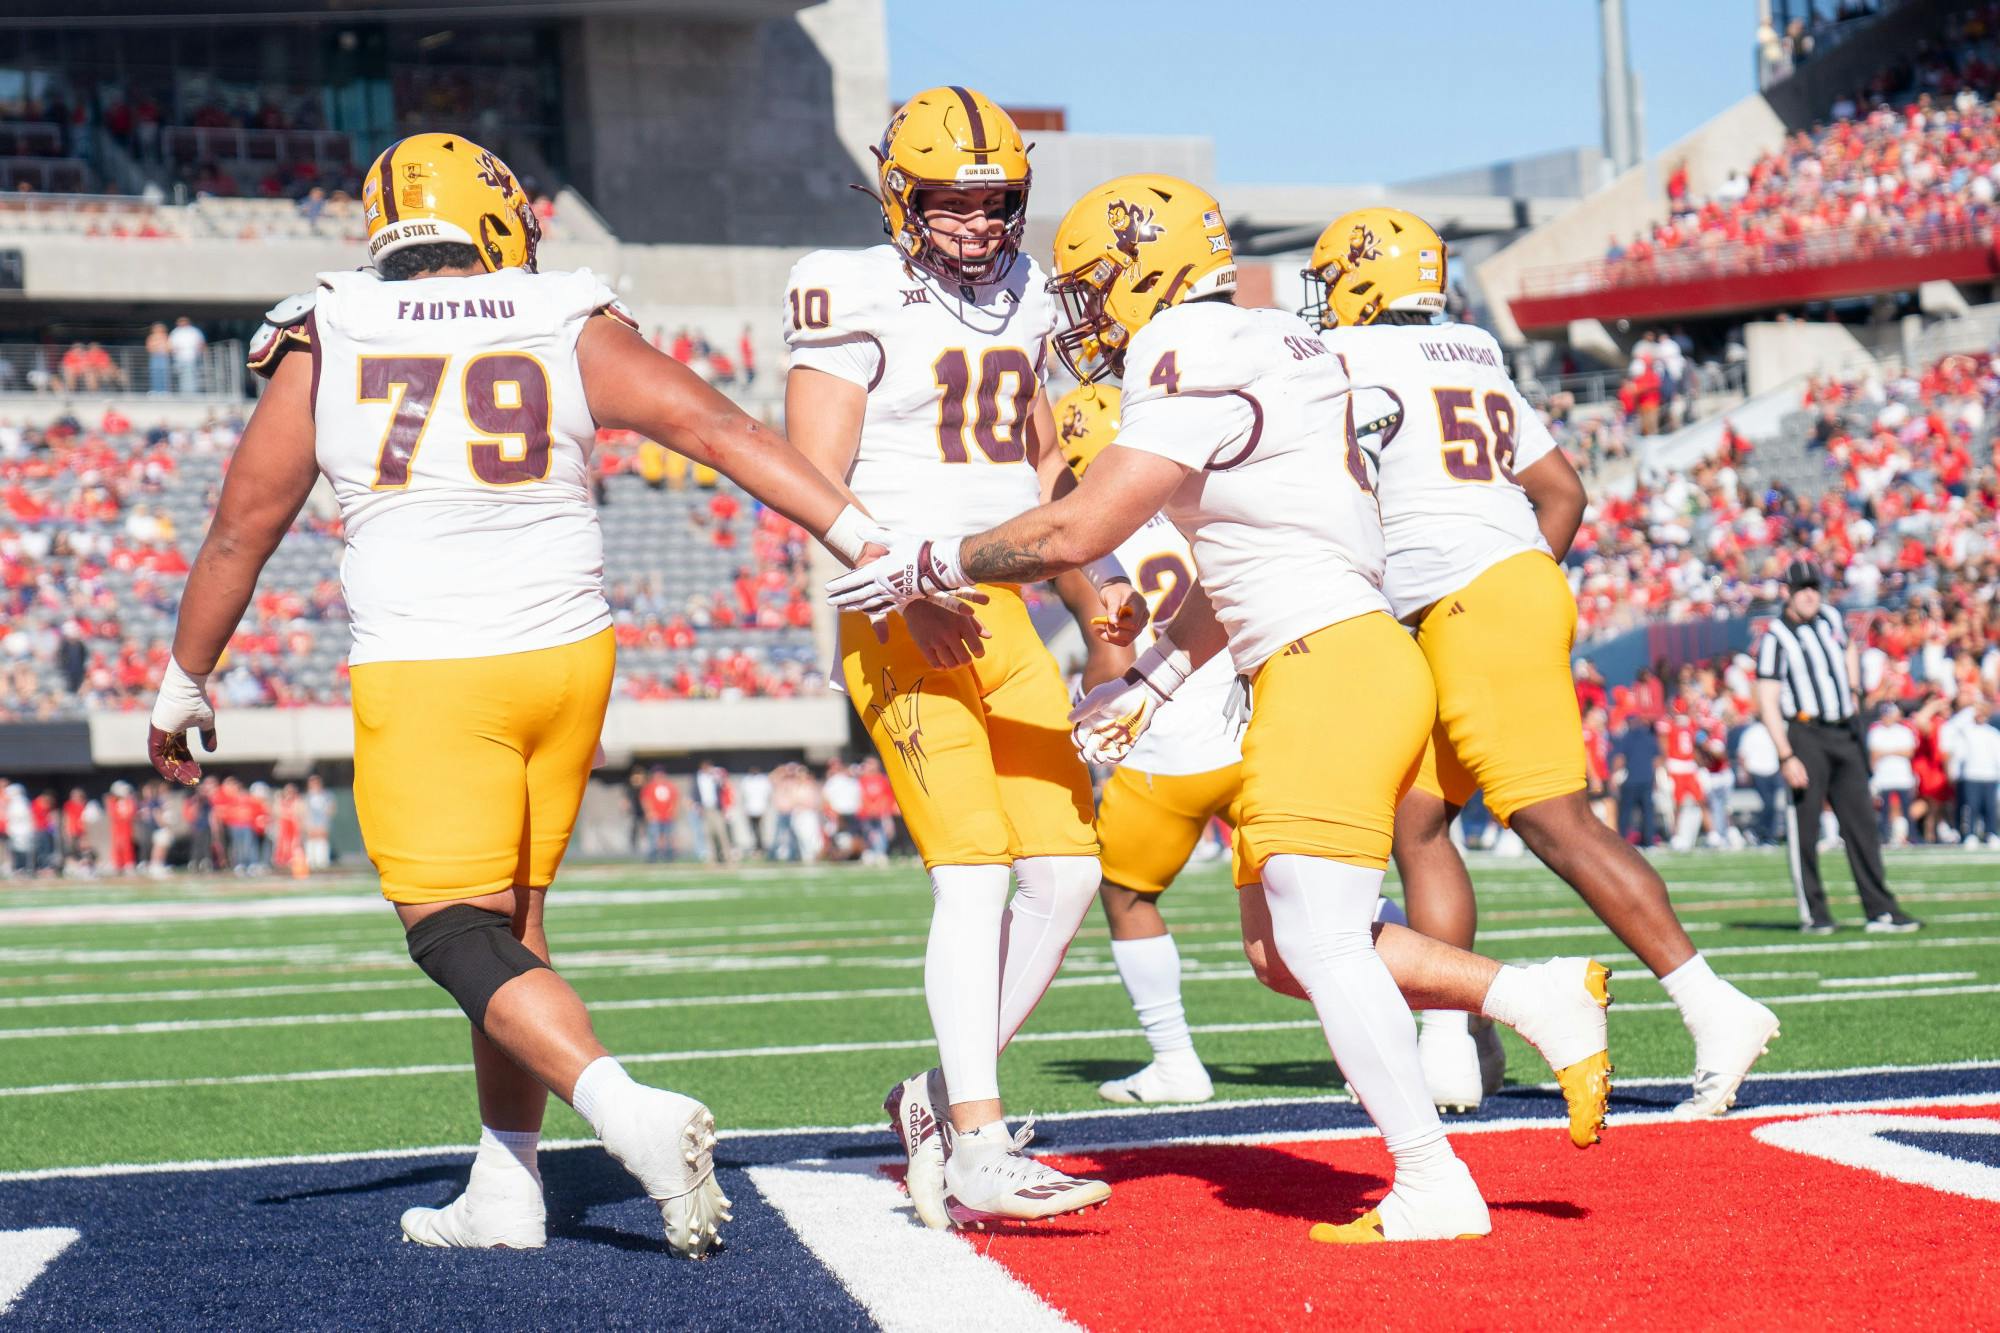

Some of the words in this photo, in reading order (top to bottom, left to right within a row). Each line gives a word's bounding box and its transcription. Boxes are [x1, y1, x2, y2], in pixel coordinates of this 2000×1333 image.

[980, 167, 1000, 175] DEVILS
[369, 229, 401, 256] ARIZONA
[402, 224, 440, 238] STATE
[396, 298, 516, 321] FAUTANU
[789, 287, 832, 332] 10
[899, 286, 931, 307] XII
[1149, 350, 1182, 395] 4
[356, 350, 554, 491] 79
[930, 345, 1039, 465] 10
[1430, 386, 1519, 486] 58
[904, 564, 914, 596] adidas
[1136, 550, 1198, 644] 2
[909, 1102, 921, 1157] adidas
